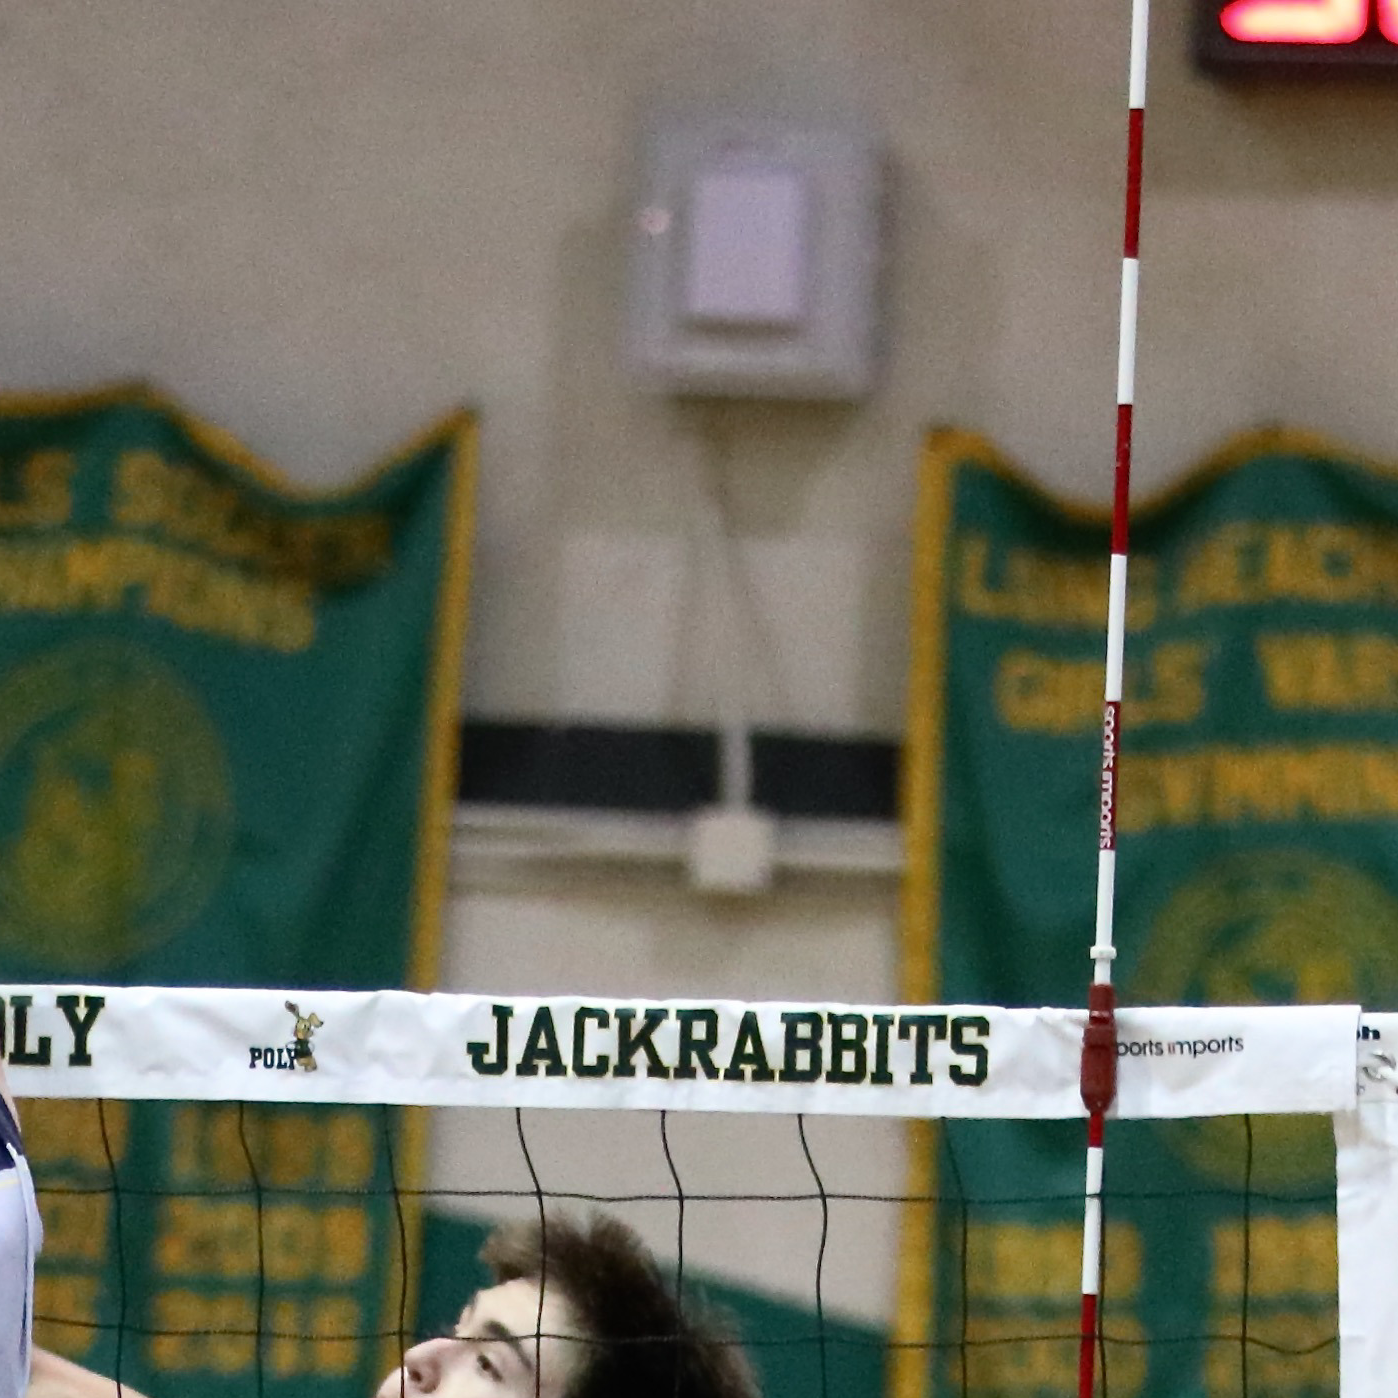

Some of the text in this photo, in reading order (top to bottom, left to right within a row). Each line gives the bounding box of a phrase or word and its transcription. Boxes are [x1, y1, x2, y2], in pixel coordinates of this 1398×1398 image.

[466, 1003, 991, 1086] JACKRABBITS
[1116, 1034, 1245, 1059] ports imports
[248, 1046, 300, 1071] POLY
